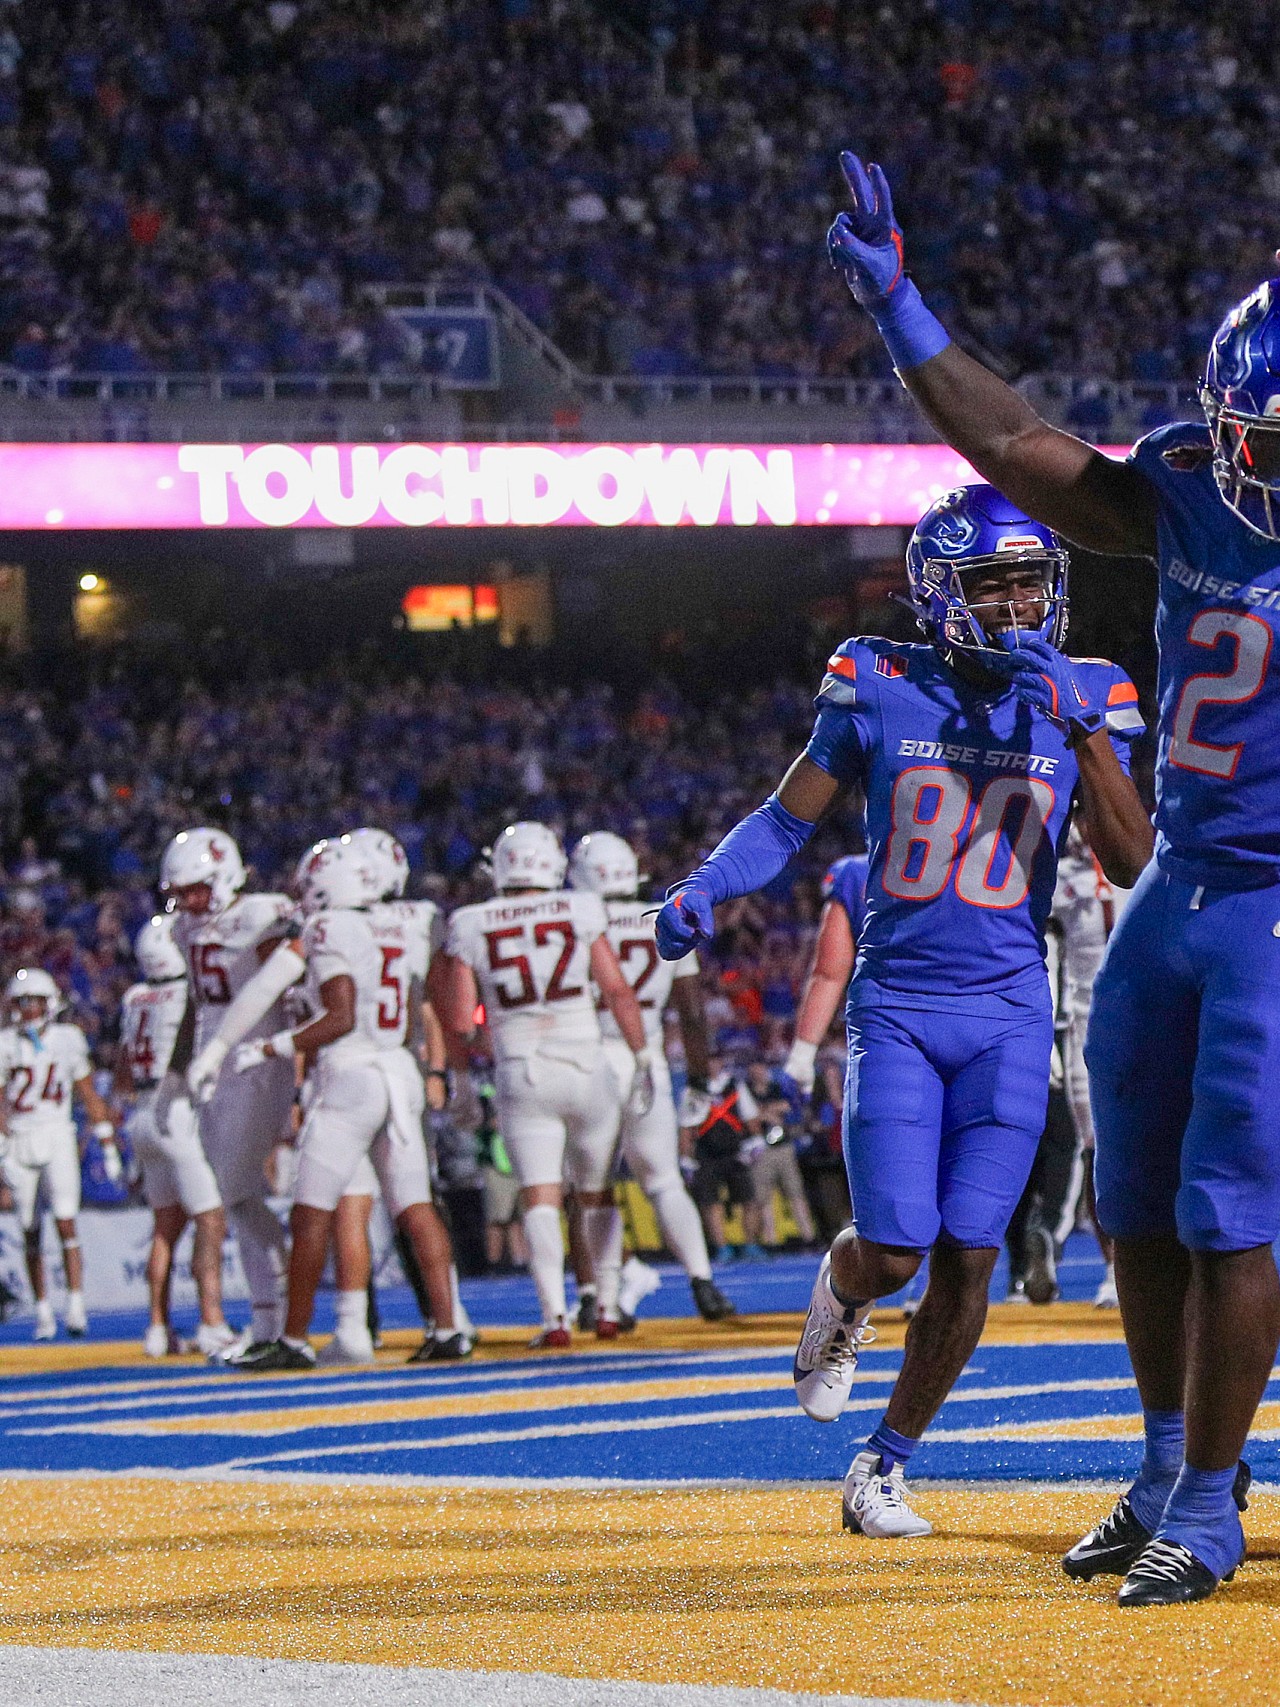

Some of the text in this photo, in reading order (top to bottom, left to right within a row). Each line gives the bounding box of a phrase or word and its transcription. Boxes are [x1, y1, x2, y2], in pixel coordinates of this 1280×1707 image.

[178, 444, 797, 526] TOUCHDOWN
[1167, 559, 1242, 600] BOISE
[1167, 607, 1274, 780] 2
[897, 739, 1060, 775] BOISE STATE
[882, 765, 1055, 909] 80
[190, 942, 232, 1005] 15
[378, 946, 406, 1030] 5
[484, 920, 584, 1010] 52
[8, 1063, 64, 1113] 24
